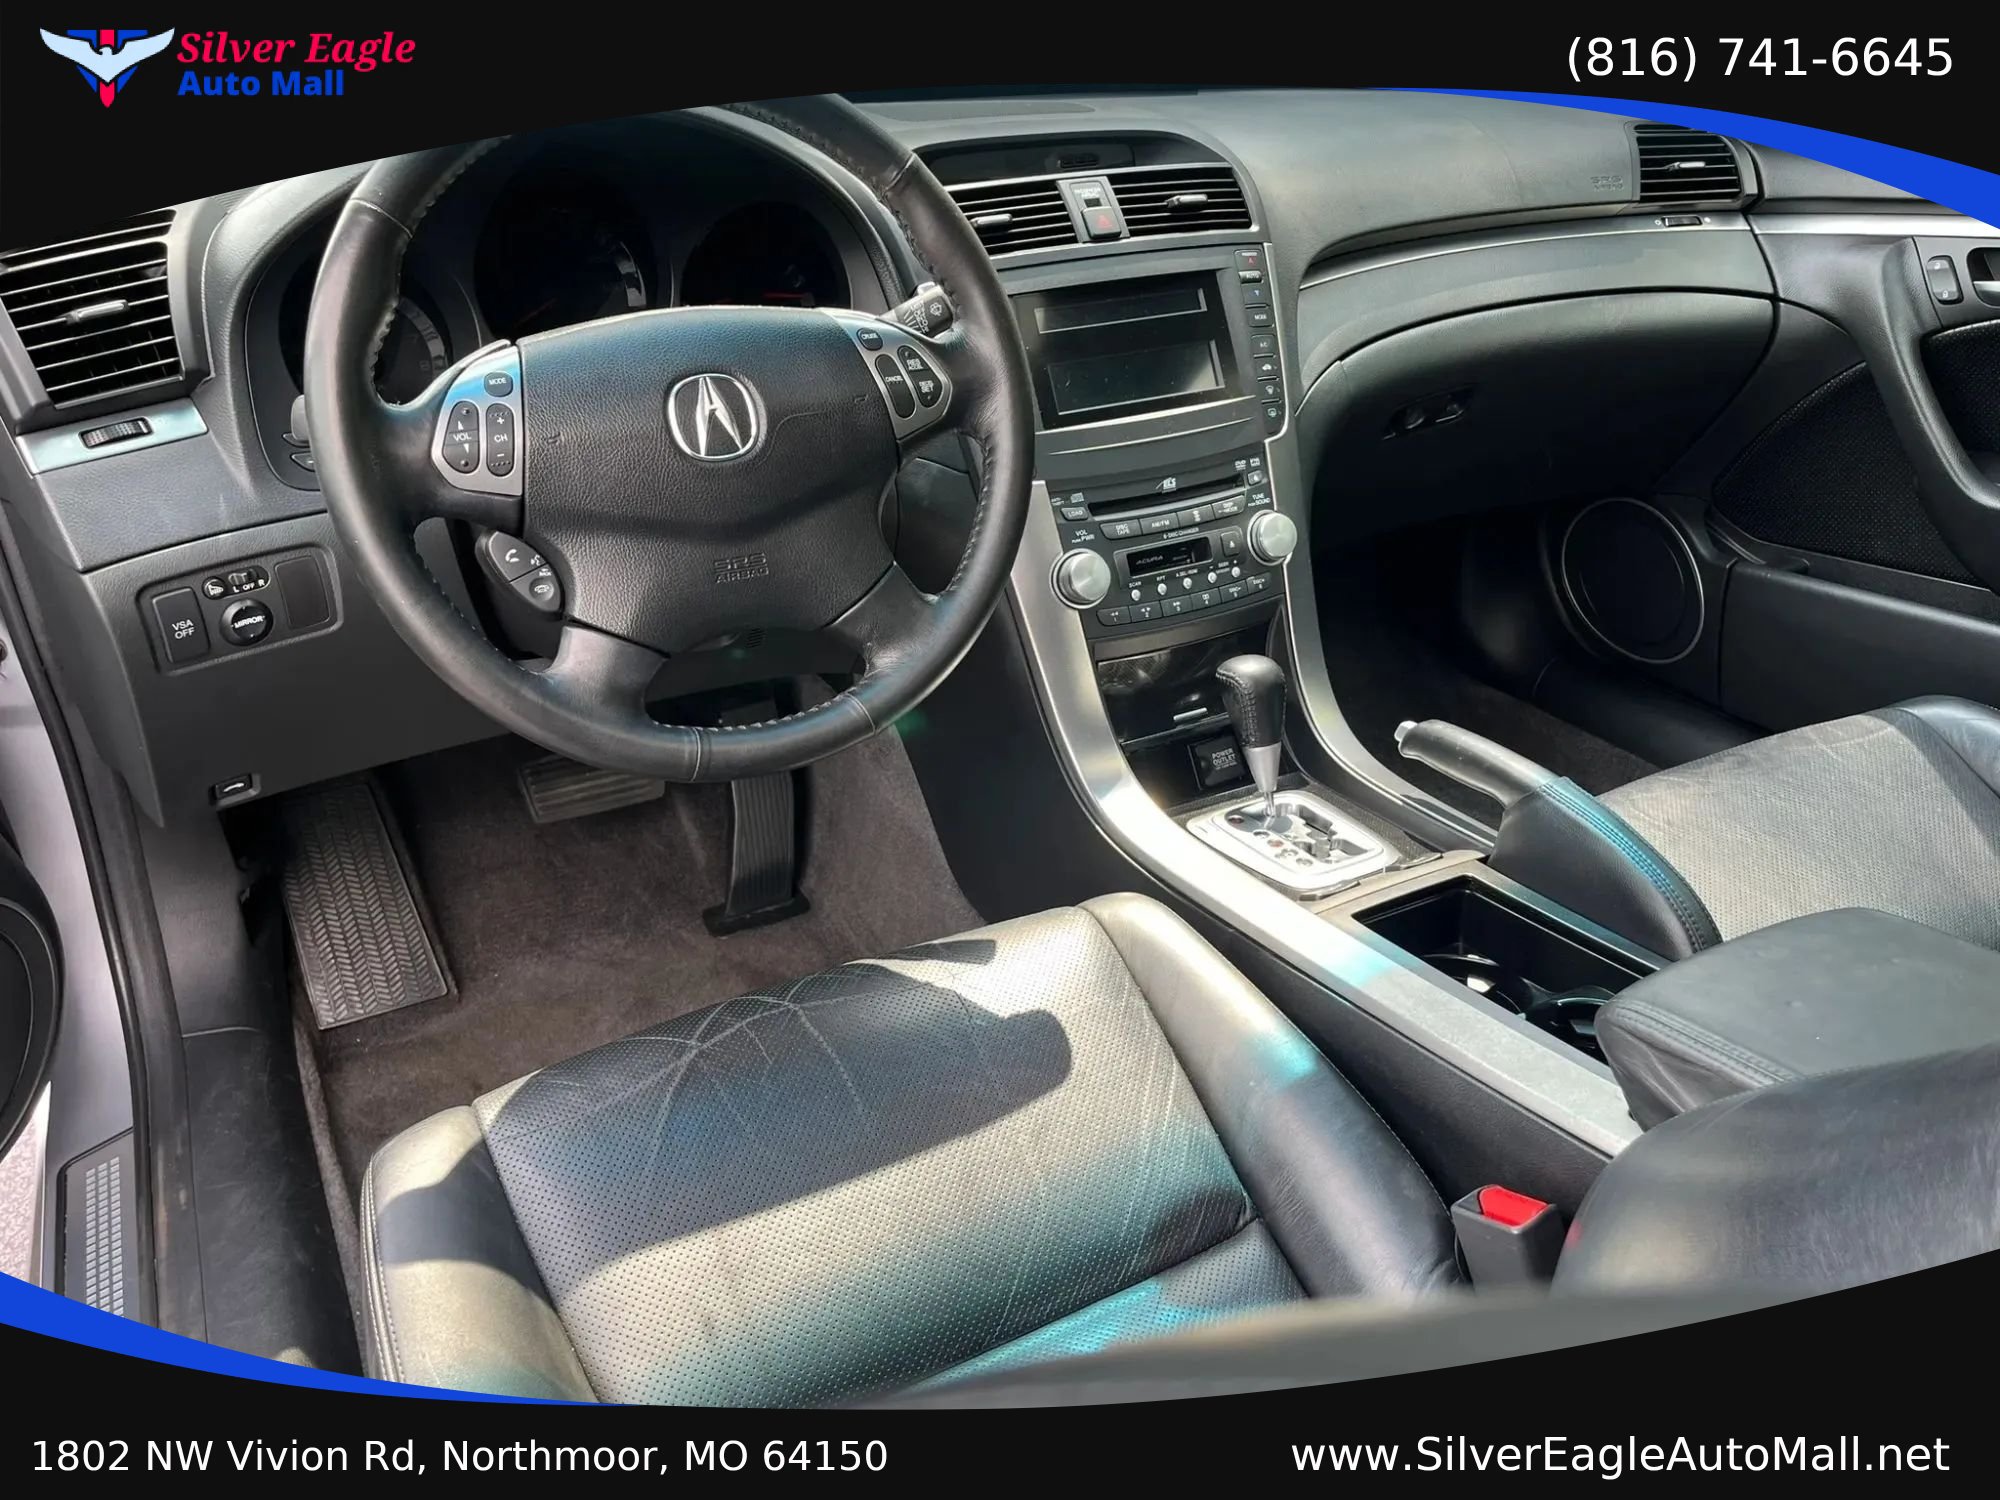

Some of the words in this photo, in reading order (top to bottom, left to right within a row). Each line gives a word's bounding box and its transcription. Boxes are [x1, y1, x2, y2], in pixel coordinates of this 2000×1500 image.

[489, 377, 507, 385] MODE
[453, 433, 472, 441] VOL
[494, 434, 508, 443] CH
[1075, 529, 1088, 537] VOL
[714, 553, 767, 575] SRS
[242, 582, 255, 591] OFF
[257, 579, 265, 587] R
[172, 619, 194, 630] VSA
[234, 615, 263, 629] MIRROR
[174, 629, 195, 639] OFF
